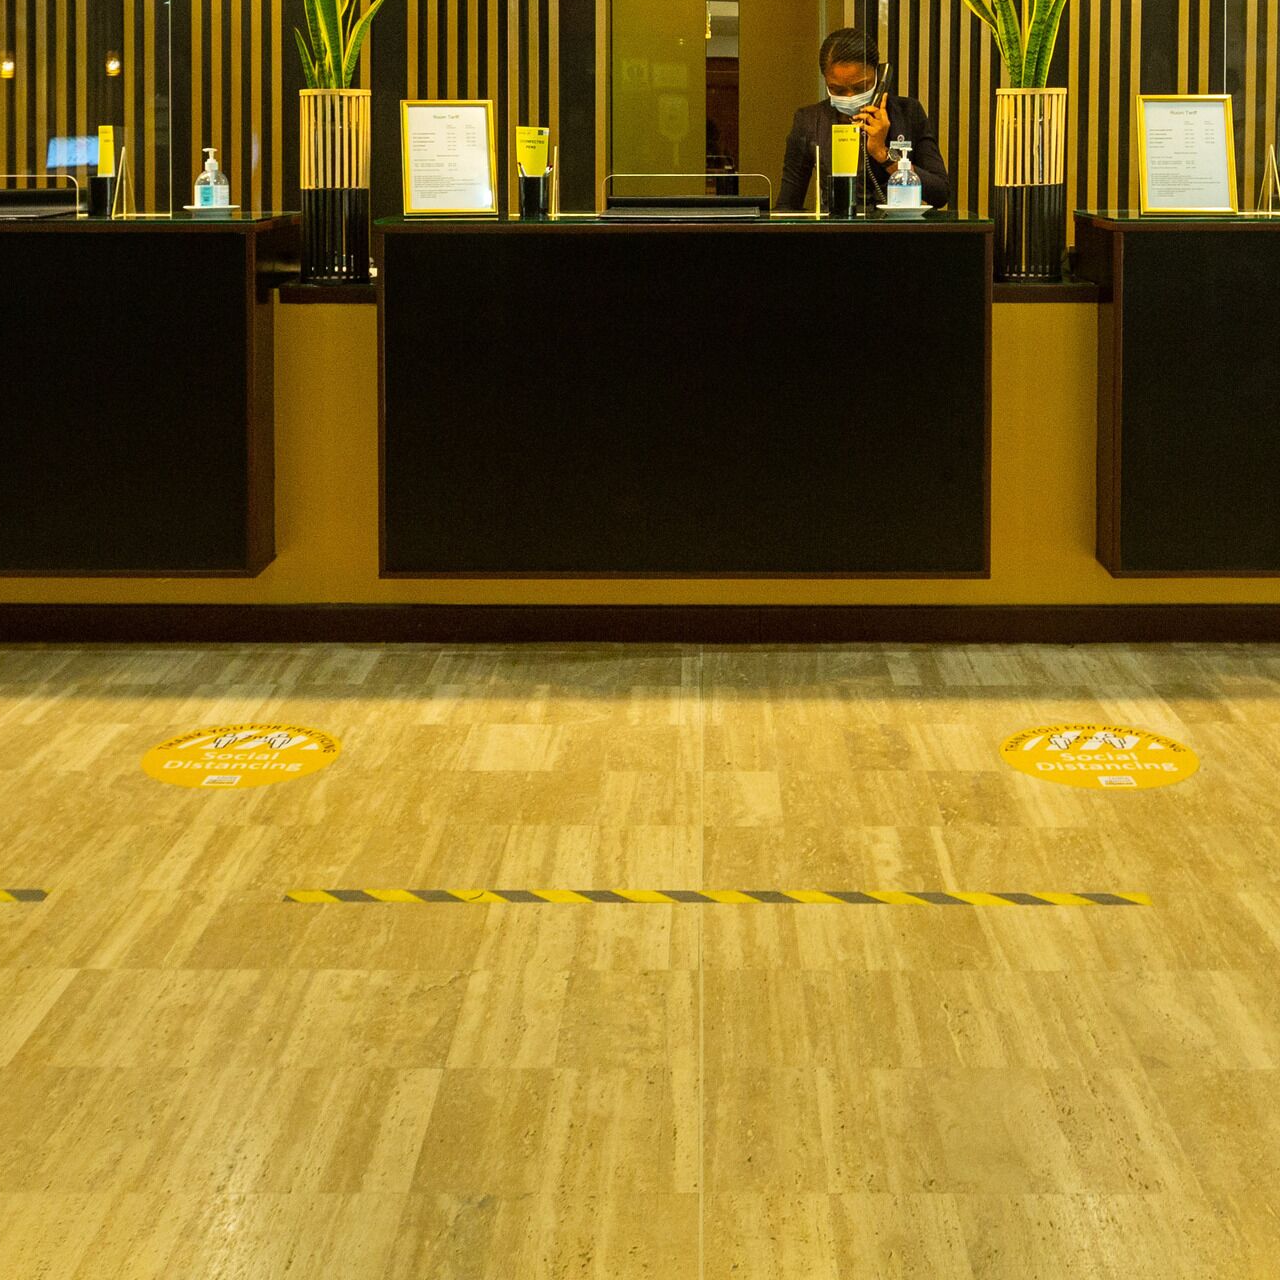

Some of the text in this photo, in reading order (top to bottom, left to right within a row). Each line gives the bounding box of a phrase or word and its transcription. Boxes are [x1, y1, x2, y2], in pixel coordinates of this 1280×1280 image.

[1102, 726, 1188, 754] PRACTICING
[202, 752, 281, 761] Social
[1059, 752, 1139, 761] Social
[162, 760, 305, 772] Distancing
[1034, 761, 1179, 773] Distancing
